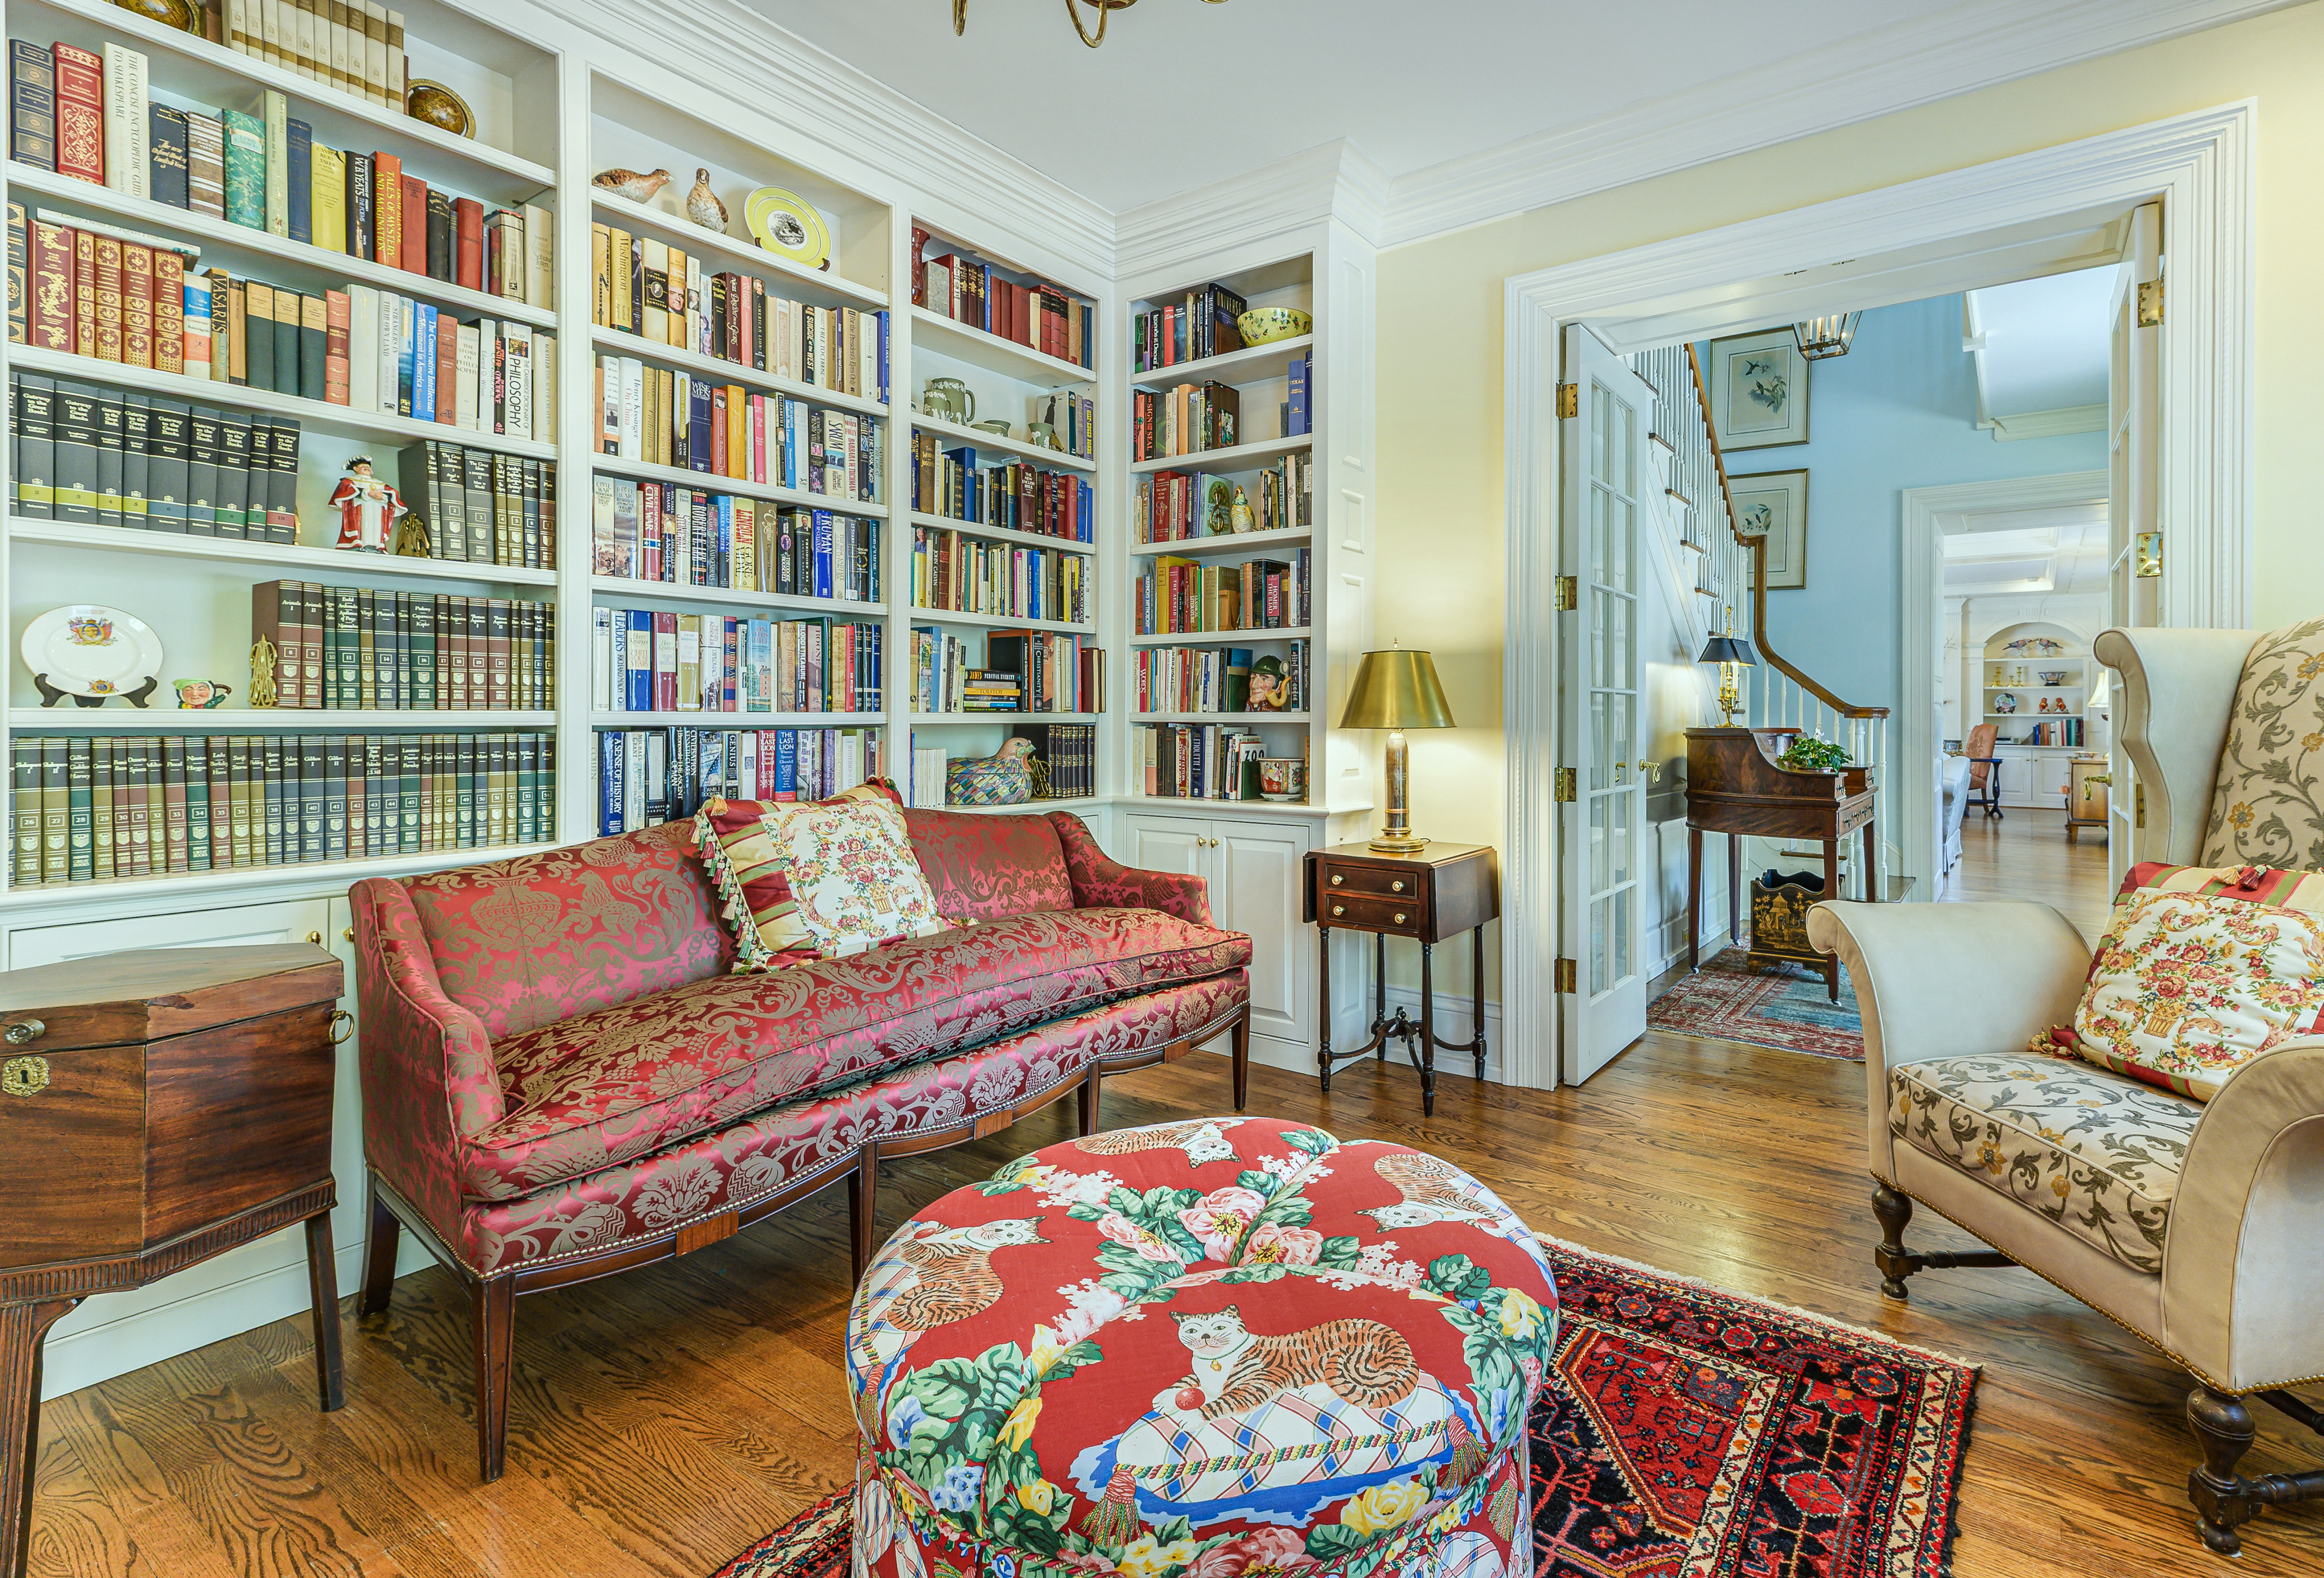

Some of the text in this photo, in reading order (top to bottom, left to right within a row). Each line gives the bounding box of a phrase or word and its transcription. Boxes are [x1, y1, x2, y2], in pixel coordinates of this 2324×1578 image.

[114, 50, 125, 119] TO SHAKESPEARE
[129, 56, 141, 196] THE CONCISE ENCYCLOPEDIC GUID
[355, 175, 365, 198] YEATS
[387, 202, 395, 212] OF
[376, 193, 385, 250] IMAGINATION
[387, 214, 395, 259] MYSTERY
[619, 238, 629, 291] Washington
[213, 277, 229, 333] VASARI'S
[400, 300, 413, 308] WILL
[1217, 291, 1241, 316] UNIVERSE
[417, 317, 426, 353] Movement
[416, 361, 425, 387] America
[456, 367, 476, 375] SOPHY
[23, 393, 51, 403] Gateway
[509, 358, 520, 428] PHILOSOPHY
[625, 388, 632, 401] On
[692, 382, 710, 391] WISE
[692, 388, 710, 397] MEN
[158, 416, 183, 425] Gateway
[632, 404, 641, 439] Kissinger
[829, 421, 843, 450] SARUM
[596, 481, 611, 490] CIVIL
[616, 486, 634, 494] CIVIL
[645, 486, 654, 531] CIVIL WAR
[821, 515, 832, 554] TRUMAN
[735, 546, 745, 577] VIDAL
[744, 547, 753, 579] GORE
[615, 615, 625, 651] LEADERS
[970, 671, 982, 679] JAMES
[1245, 750, 1264, 761] ZOO
[614, 769, 622, 779] OF
